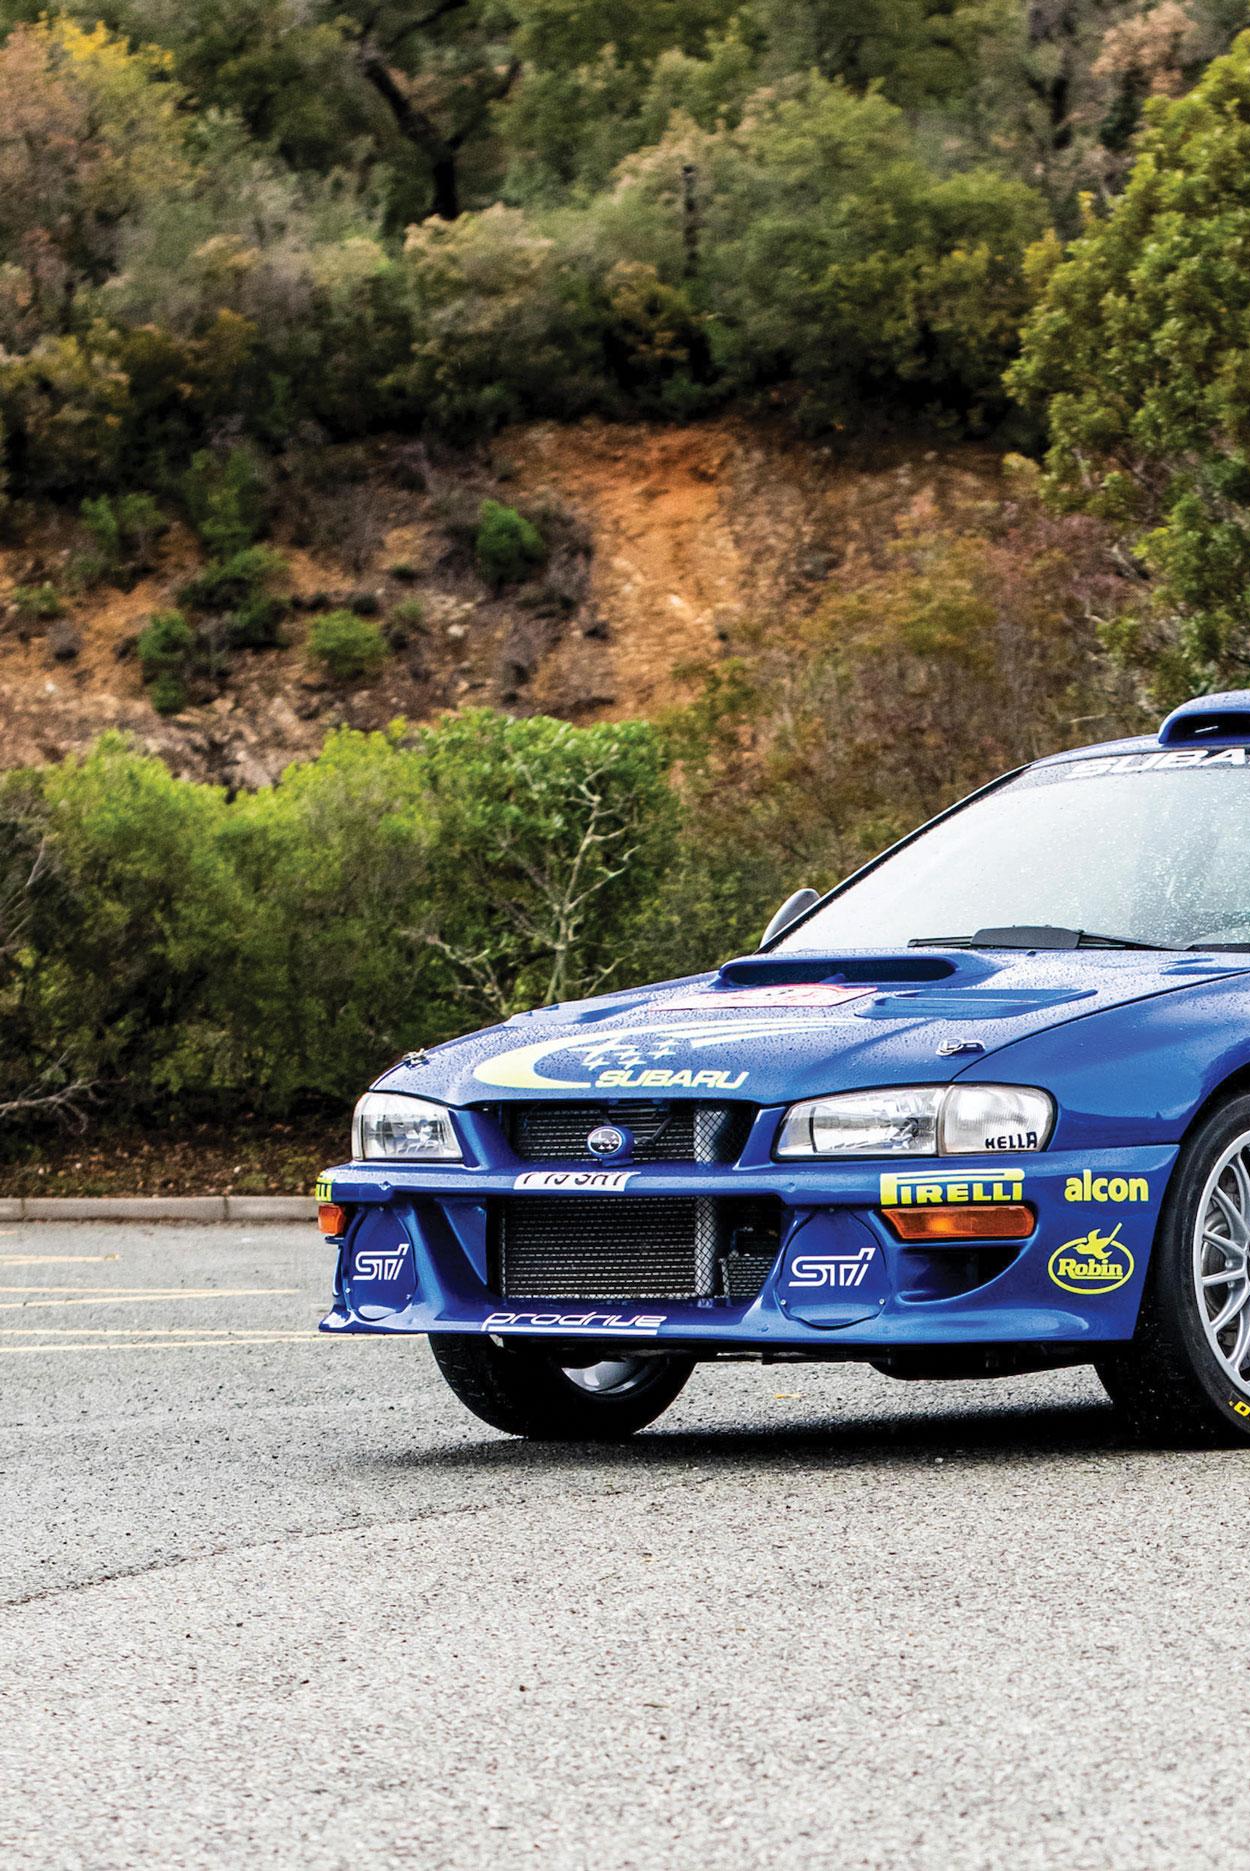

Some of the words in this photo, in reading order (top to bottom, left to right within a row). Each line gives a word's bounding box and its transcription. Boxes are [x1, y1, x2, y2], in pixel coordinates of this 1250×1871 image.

[595, 1069, 750, 1089] SUBARU
[985, 1131, 1037, 1149] HELLA
[880, 1168, 1025, 1205] PIRELLI
[1064, 1169, 1149, 1202] alcon
[1057, 1257, 1123, 1279] Robin
[482, 1312, 668, 1331] prodrive
